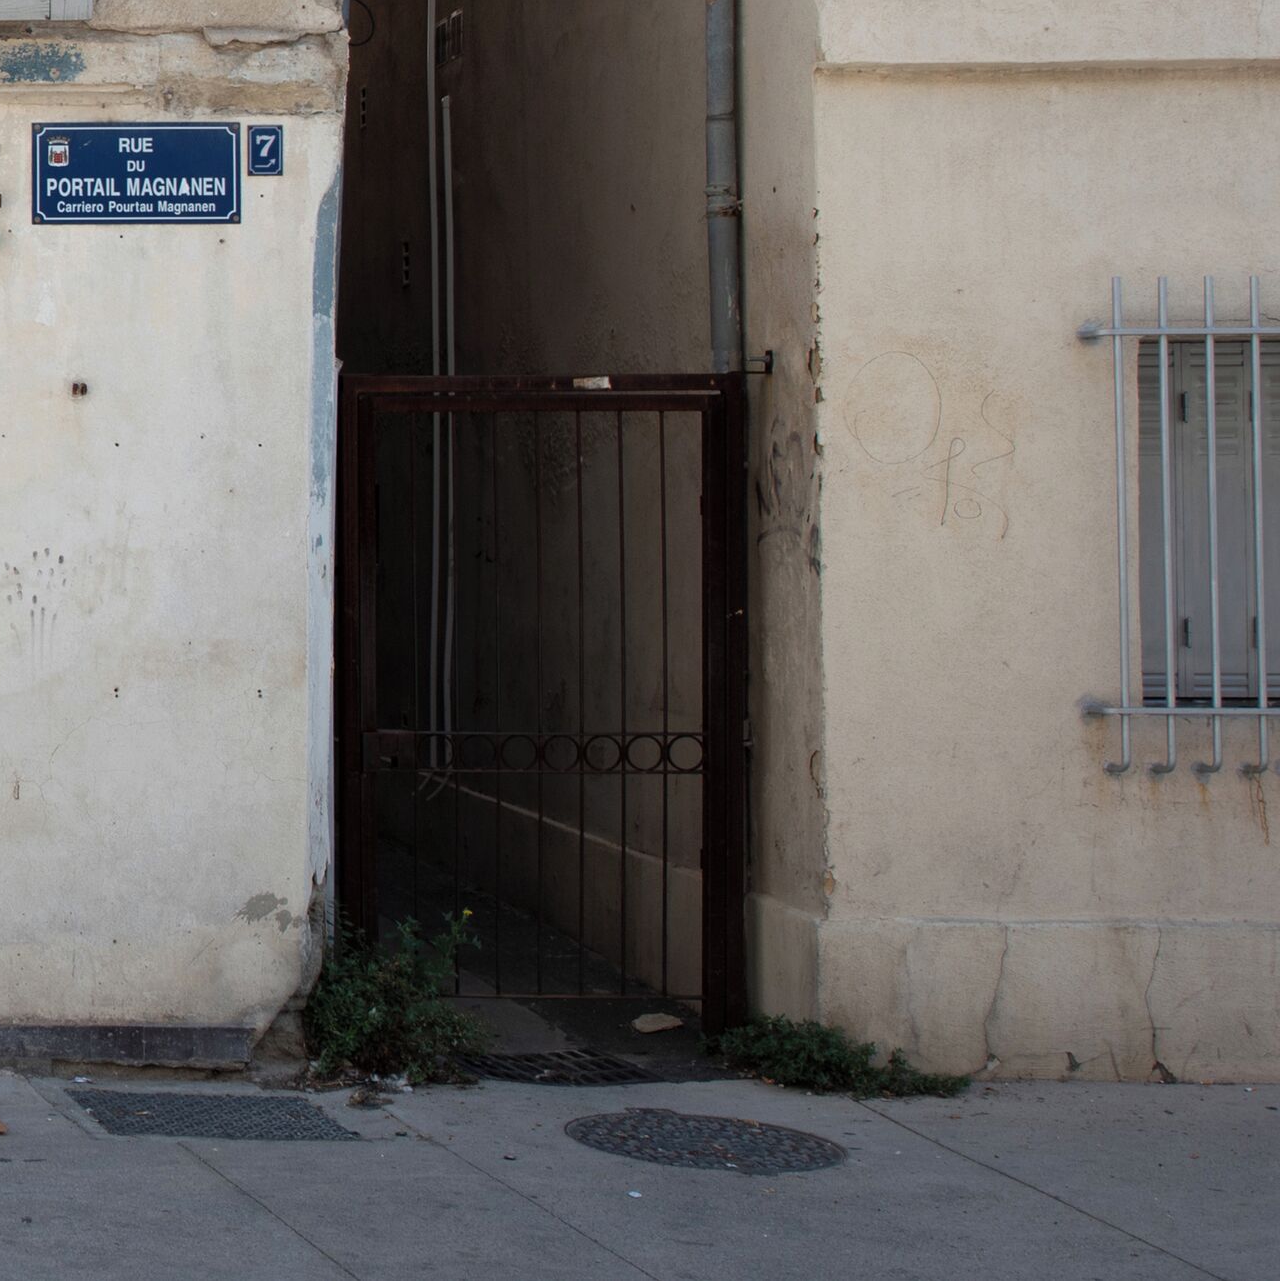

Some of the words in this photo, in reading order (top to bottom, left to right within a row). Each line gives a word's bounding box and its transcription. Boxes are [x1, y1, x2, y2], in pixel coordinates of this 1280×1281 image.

[118, 137, 153, 153] RUE
[255, 135, 276, 157] 7
[126, 160, 146, 172] DU
[46, 177, 120, 197] PORTAIL
[126, 177, 226, 197] MAGNANEN
[57, 201, 104, 213] Carriero
[108, 201, 153, 213] Pourtau
[157, 200, 216, 215] Magnanen
